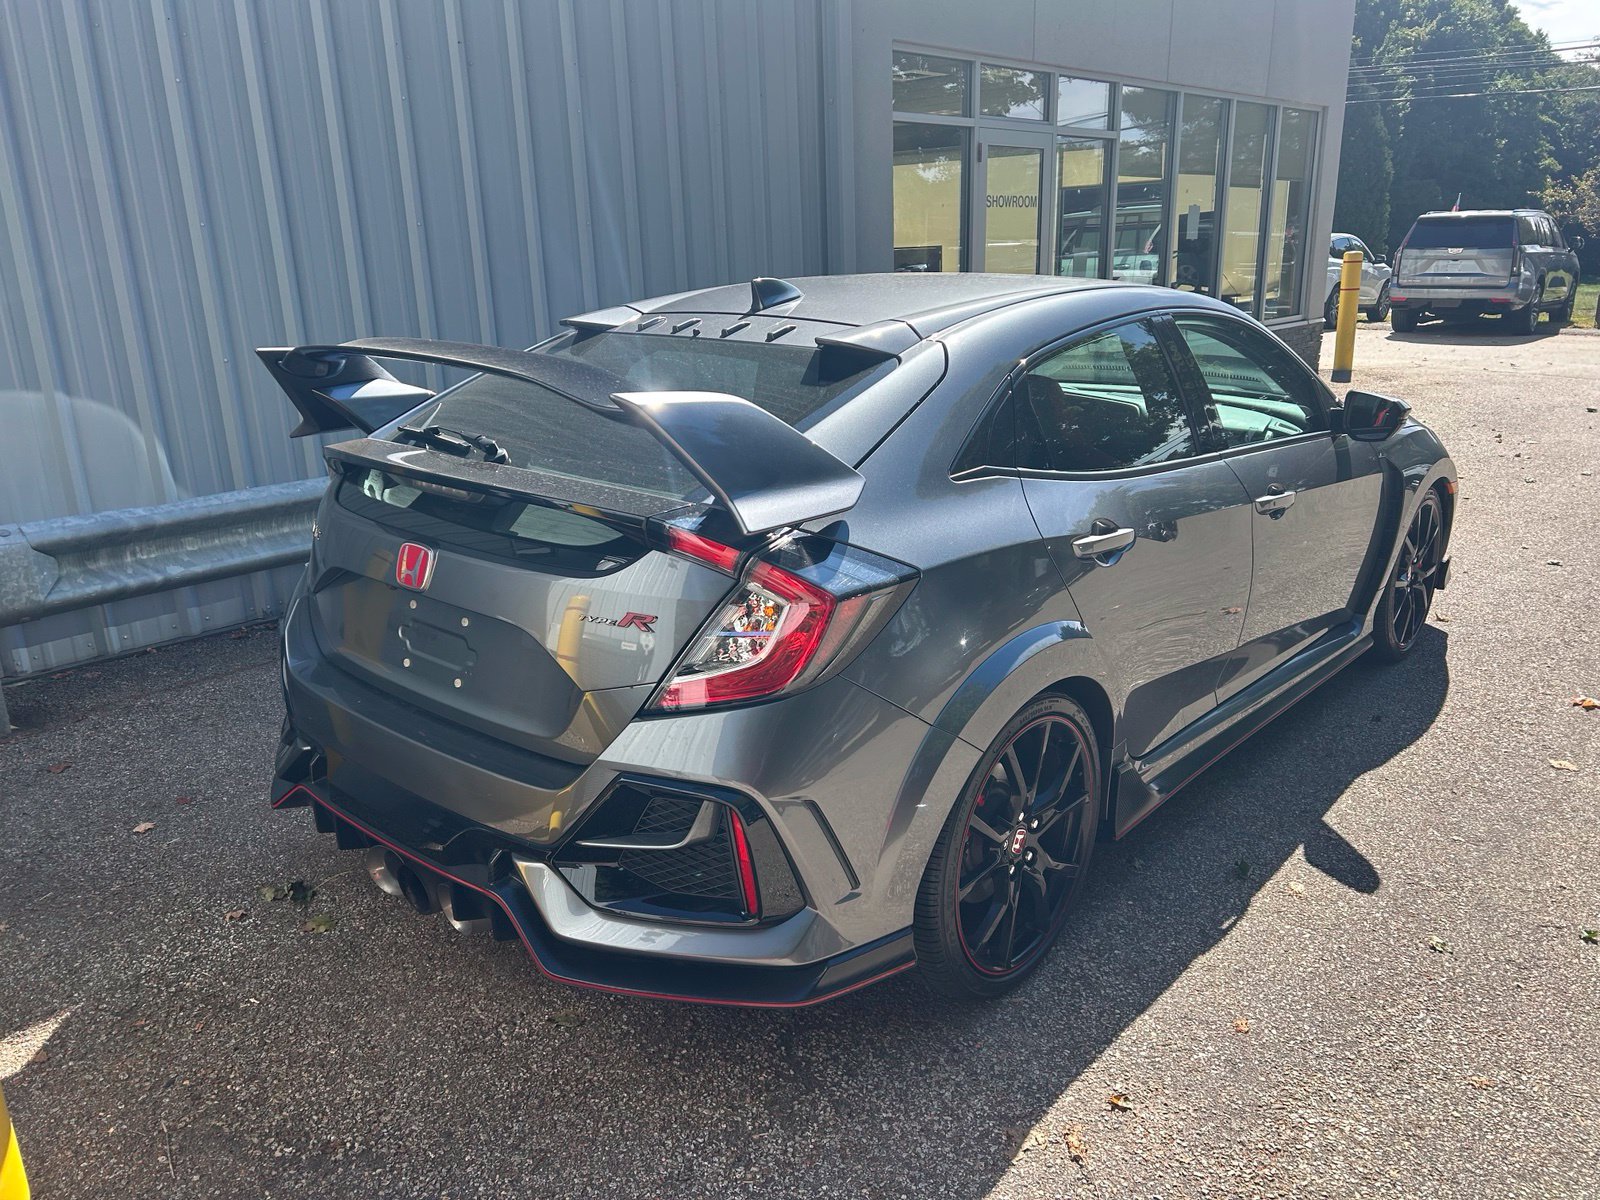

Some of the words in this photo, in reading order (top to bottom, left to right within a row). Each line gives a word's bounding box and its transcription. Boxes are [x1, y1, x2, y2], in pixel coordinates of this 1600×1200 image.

[986, 194, 1038, 208] SHOWROOM
[578, 614, 618, 627] TYPE
[617, 611, 659, 633] R
